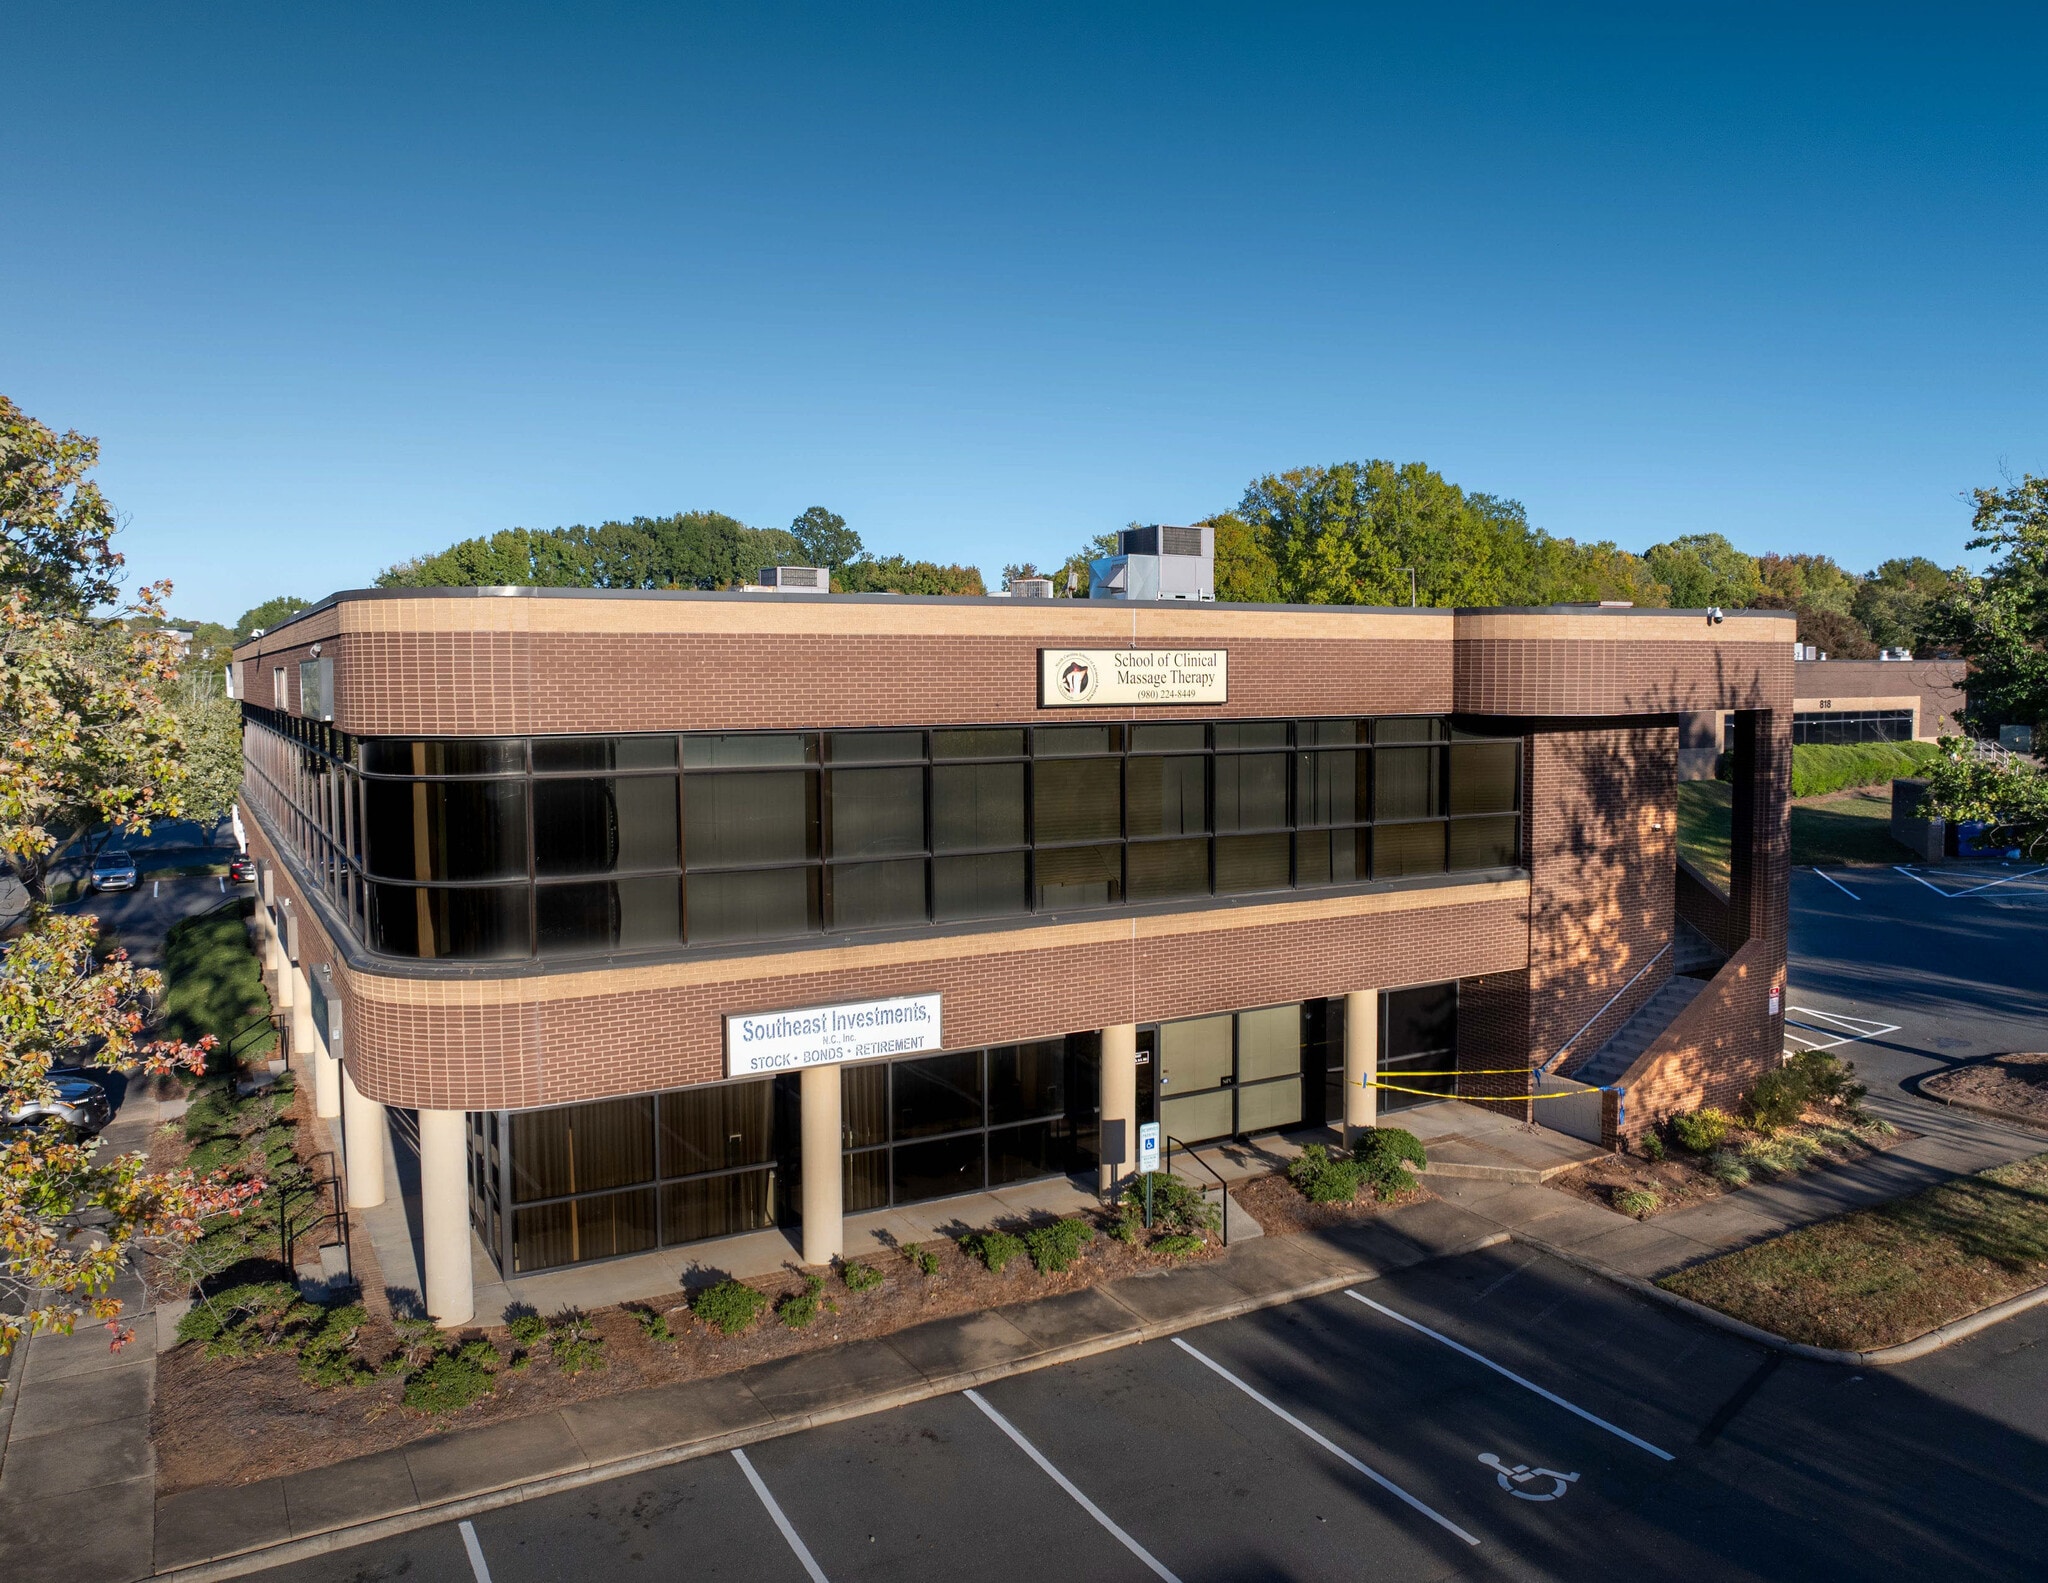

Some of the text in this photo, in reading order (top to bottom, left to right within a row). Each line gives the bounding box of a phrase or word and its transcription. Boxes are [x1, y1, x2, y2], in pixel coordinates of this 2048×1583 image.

[1114, 652, 1217, 667] School of Clinical
[1117, 670, 1216, 688] Massage Therapy
[1137, 689, 1196, 700] (980) 224-8449
[1819, 699, 1831, 708] 818
[742, 1002, 932, 1042] Southeast Investments,
[842, 1033, 857, 1043] Inc.
[750, 1036, 925, 1070] STOCK BONDS RETIREMENT
